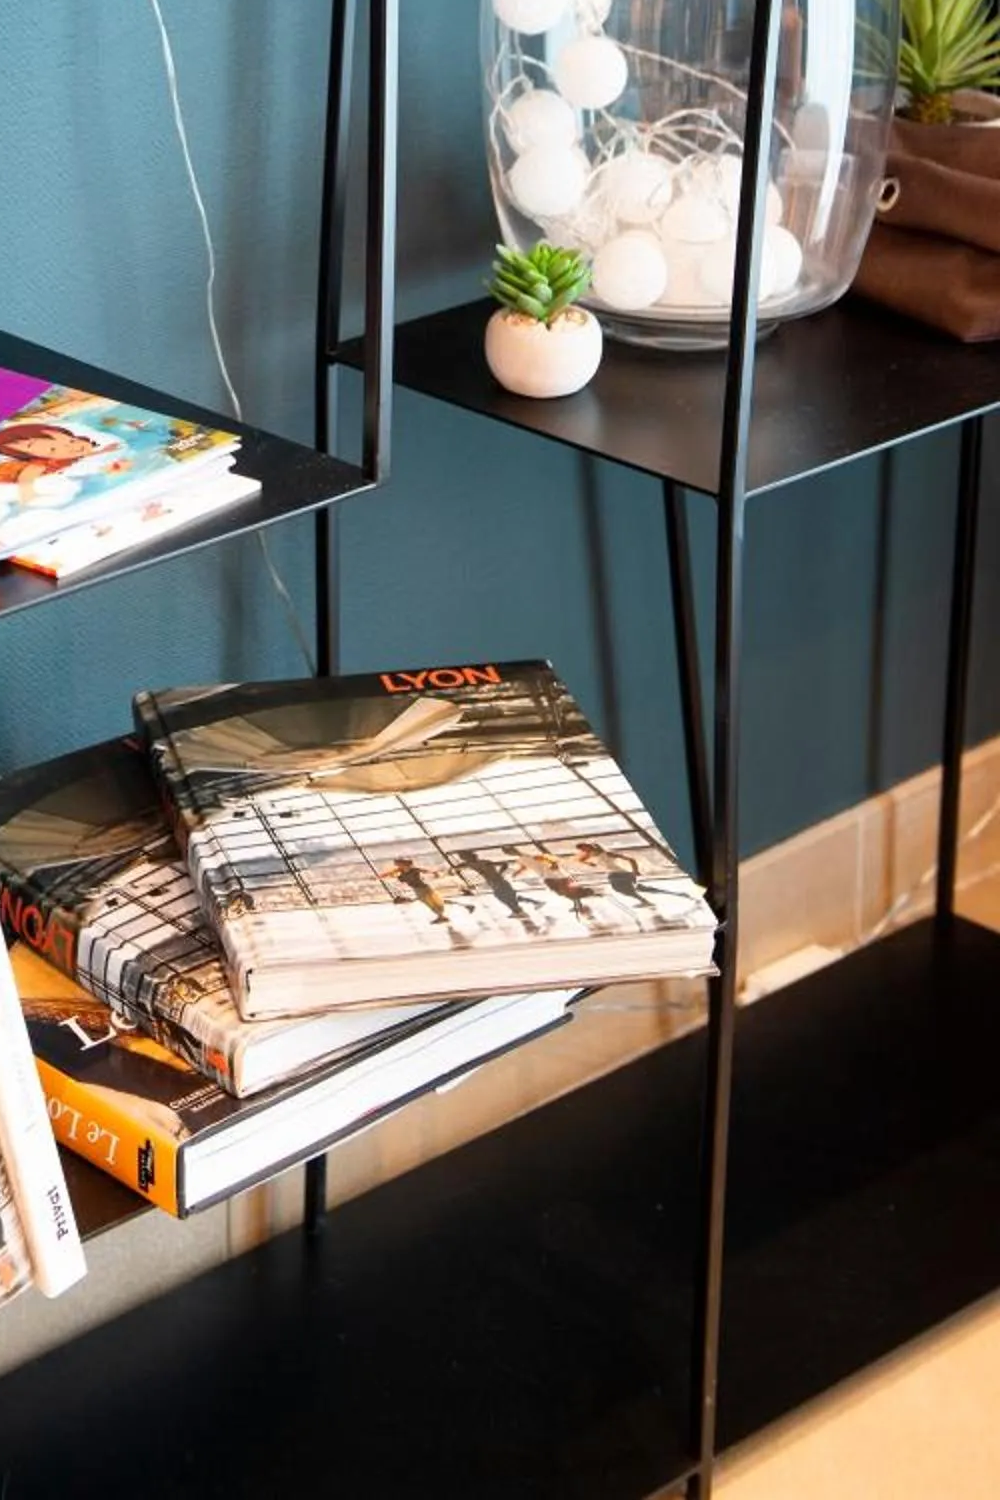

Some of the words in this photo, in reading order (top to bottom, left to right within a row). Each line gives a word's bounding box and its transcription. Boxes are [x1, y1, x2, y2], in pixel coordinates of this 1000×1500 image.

[378, 664, 503, 694] LYON
[1, 888, 75, 970] LYON
[44, 1092, 83, 1141] Lo
[87, 1117, 121, 1166] Le
